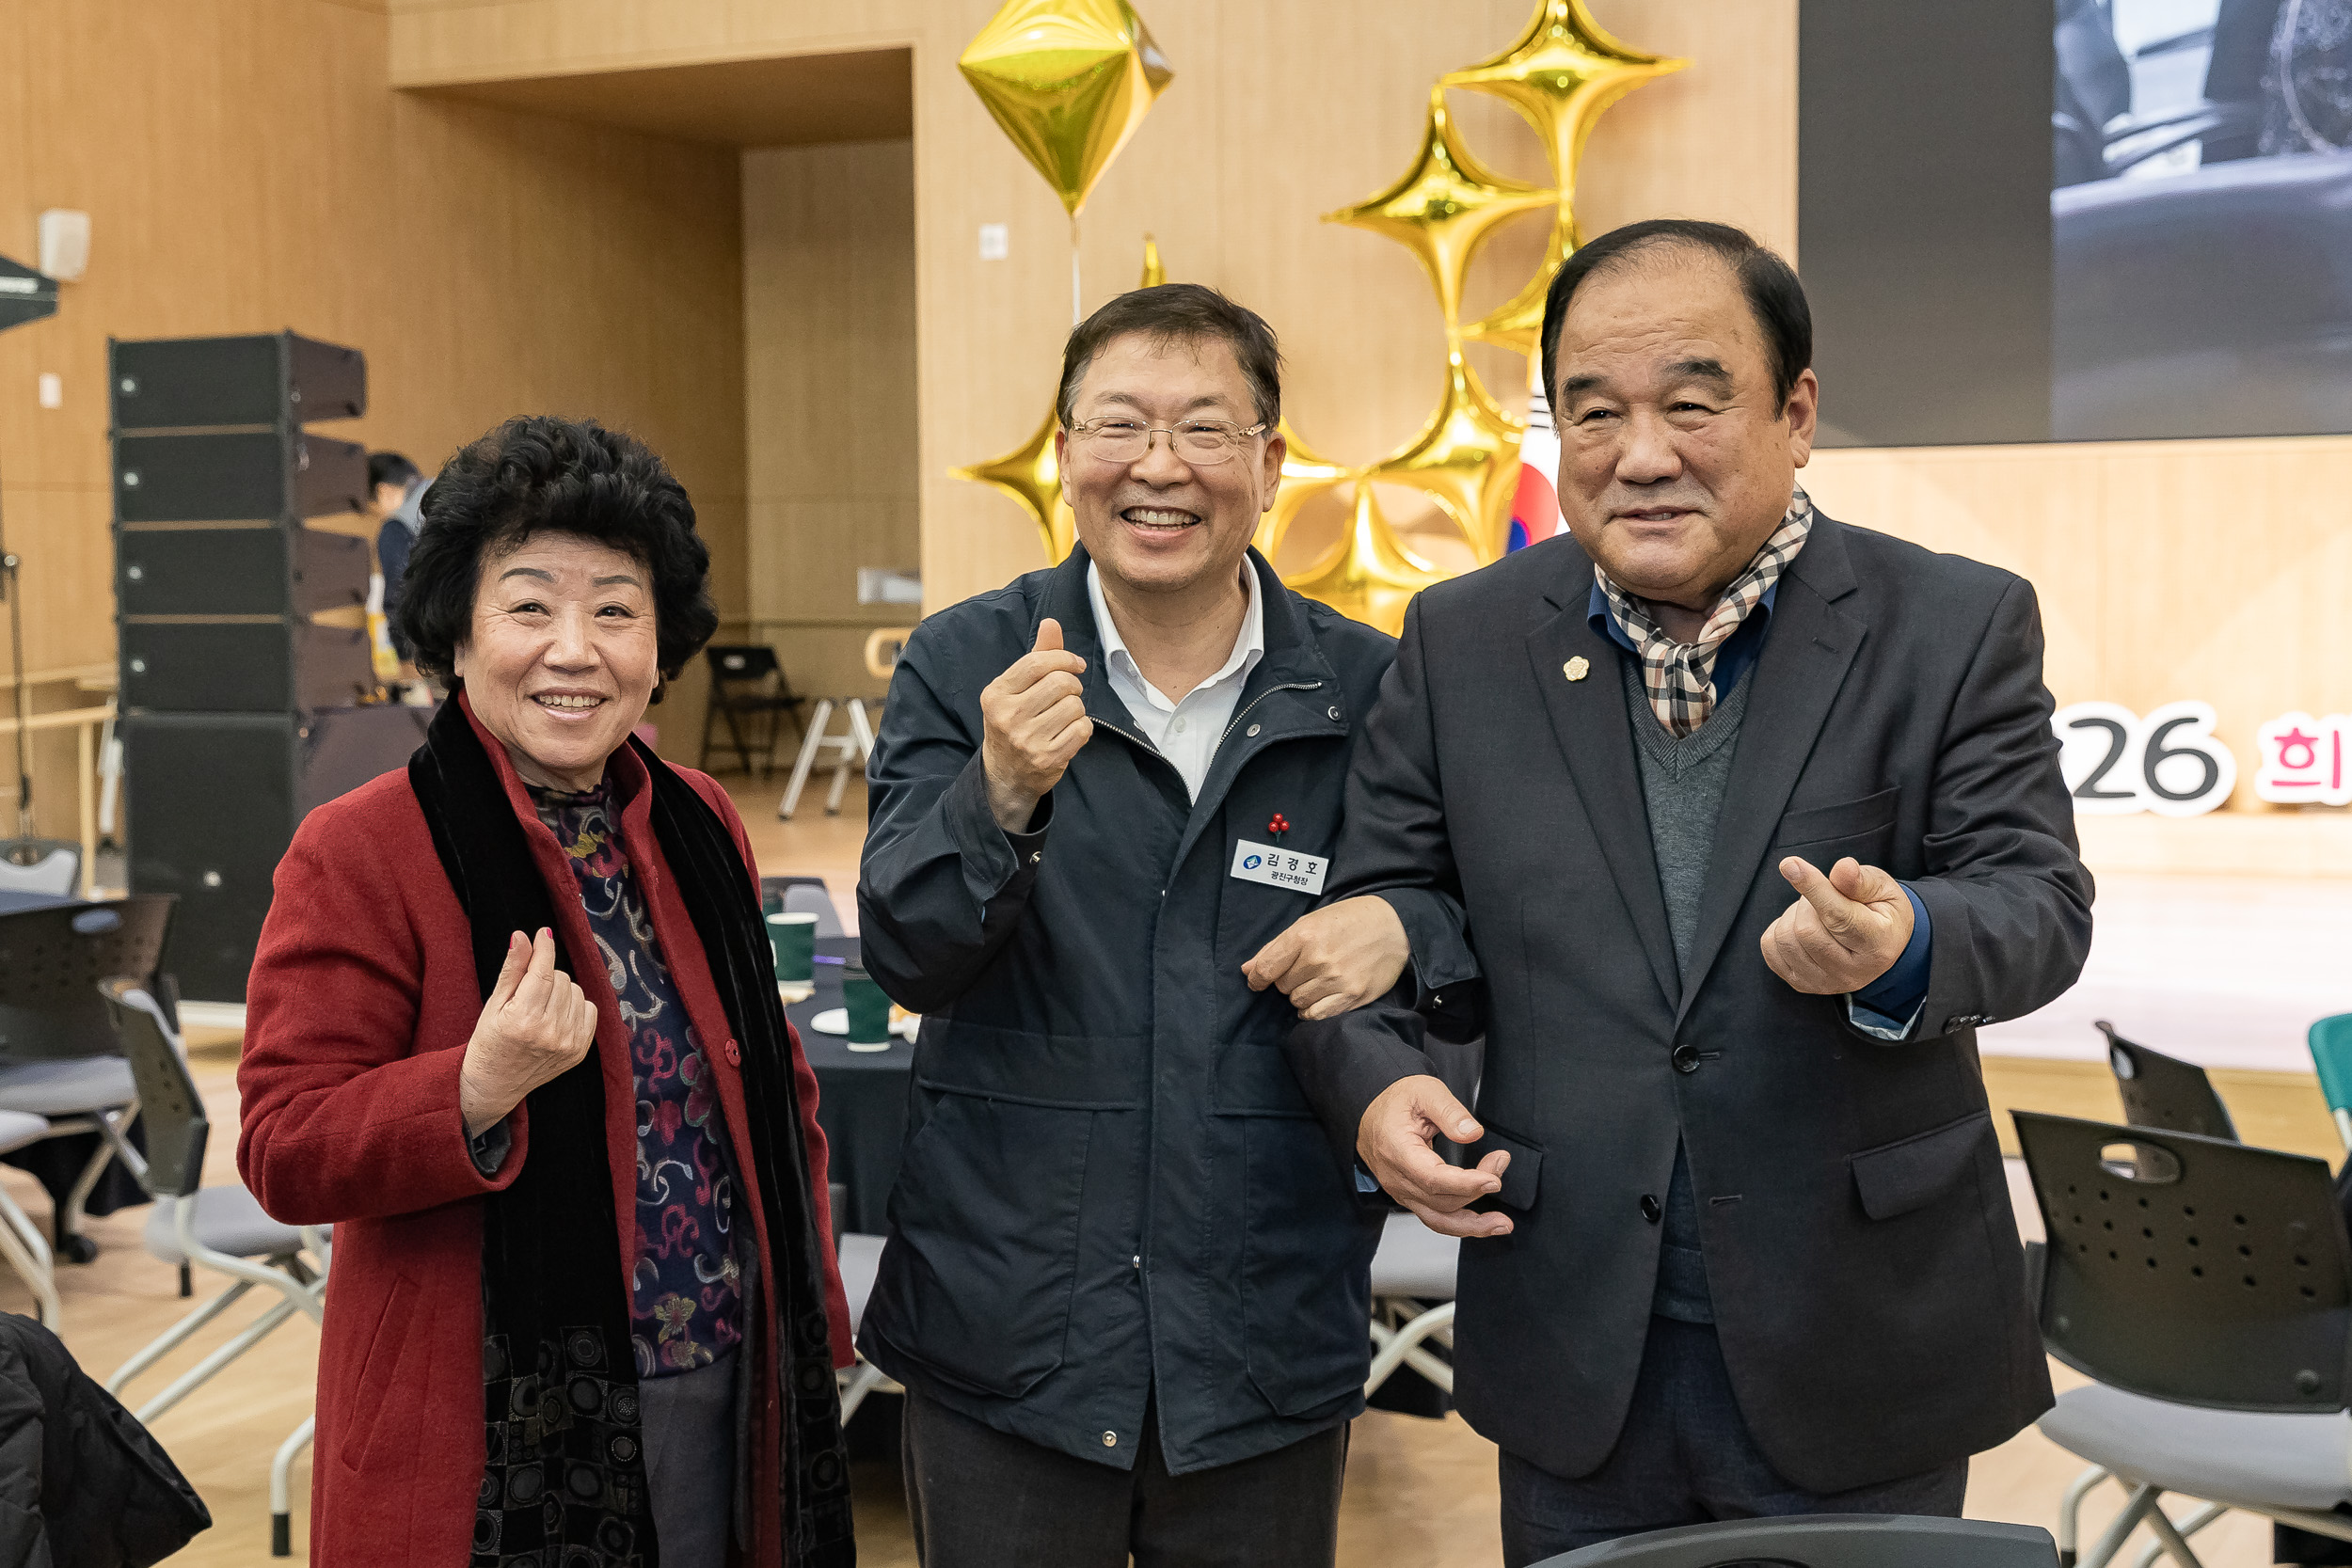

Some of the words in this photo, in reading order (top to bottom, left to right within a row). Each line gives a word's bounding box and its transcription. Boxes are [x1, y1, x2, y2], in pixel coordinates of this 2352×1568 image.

[2068, 717, 2218, 800] 26
[2271, 727, 2341, 789] 희
[1271, 870, 1309, 886] 광진구청장
